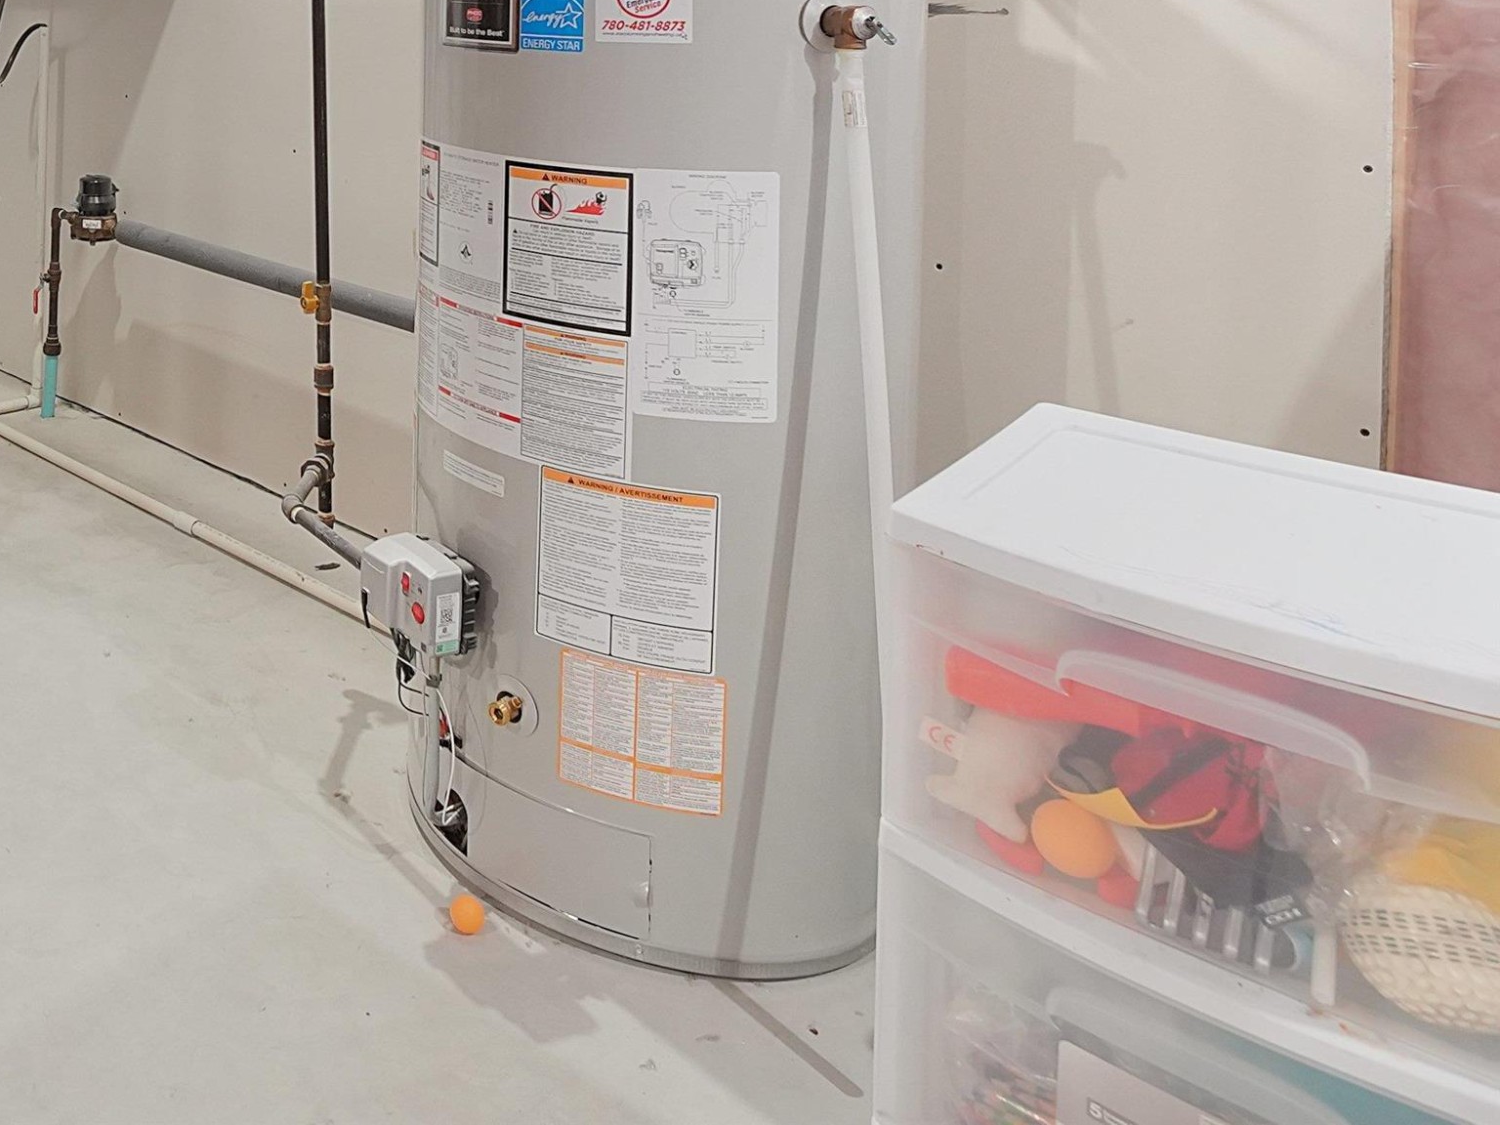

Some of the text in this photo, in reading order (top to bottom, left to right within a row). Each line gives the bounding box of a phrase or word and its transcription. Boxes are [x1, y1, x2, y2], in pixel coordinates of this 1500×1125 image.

[635, 0, 662, 13] Service
[523, 12, 564, 28] energy
[601, 19, 686, 31] 780-481-8873
[523, 38, 580, 51] ENERGY STAR
[551, 175, 588, 185] WARNING
[578, 478, 613, 492] WARNING
[619, 487, 684, 503] AVERTISSEMENT
